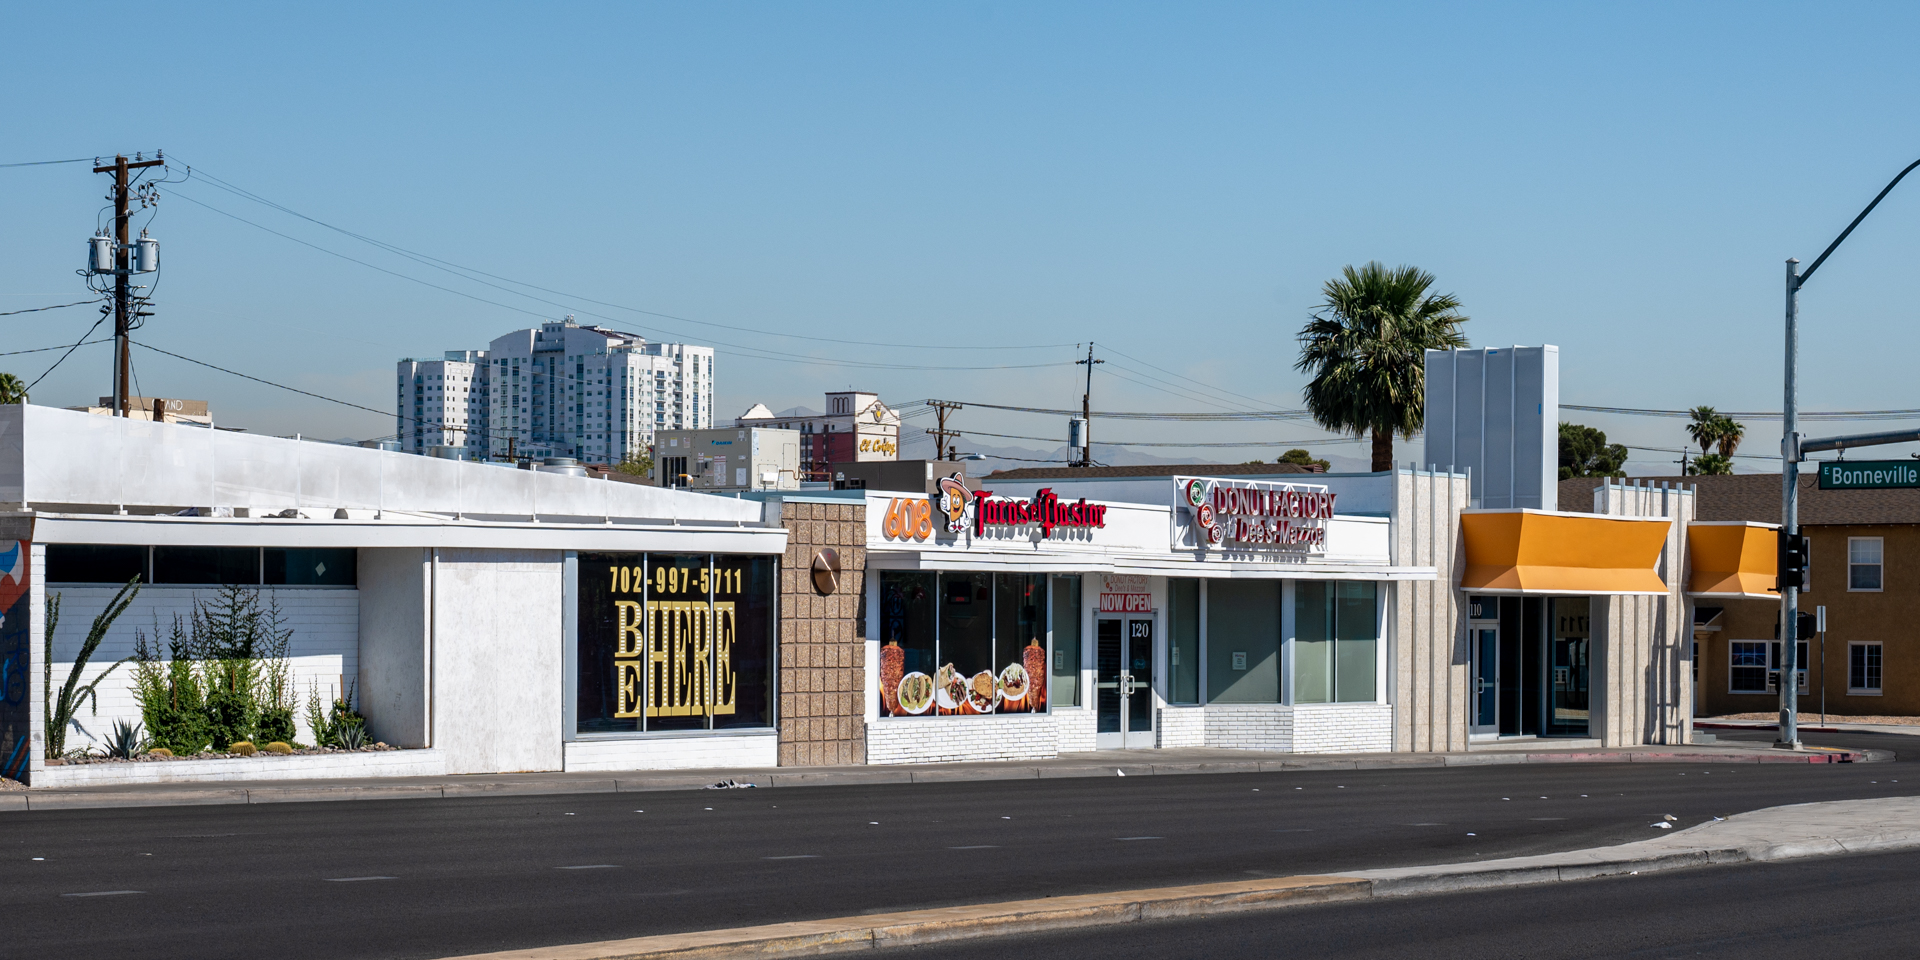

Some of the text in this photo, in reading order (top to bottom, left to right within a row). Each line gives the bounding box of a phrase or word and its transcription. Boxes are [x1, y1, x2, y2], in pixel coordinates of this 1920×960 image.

[152, 398, 183, 411] AND
[860, 439, 871, 452] El
[1824, 466, 1917, 484] E Bonneville
[1214, 487, 1338, 519] DONUT FACTORY
[884, 497, 933, 540] 608
[972, 490, 1029, 537] Tacos
[1037, 487, 1107, 539] Pastor
[610, 566, 742, 594] 702-997-5711
[1111, 575, 1127, 583] DONUT
[1101, 594, 1151, 611] NOW OPEN
[1470, 603, 1482, 616] 110
[1131, 623, 1149, 638] 120
[646, 601, 736, 718] HERE
